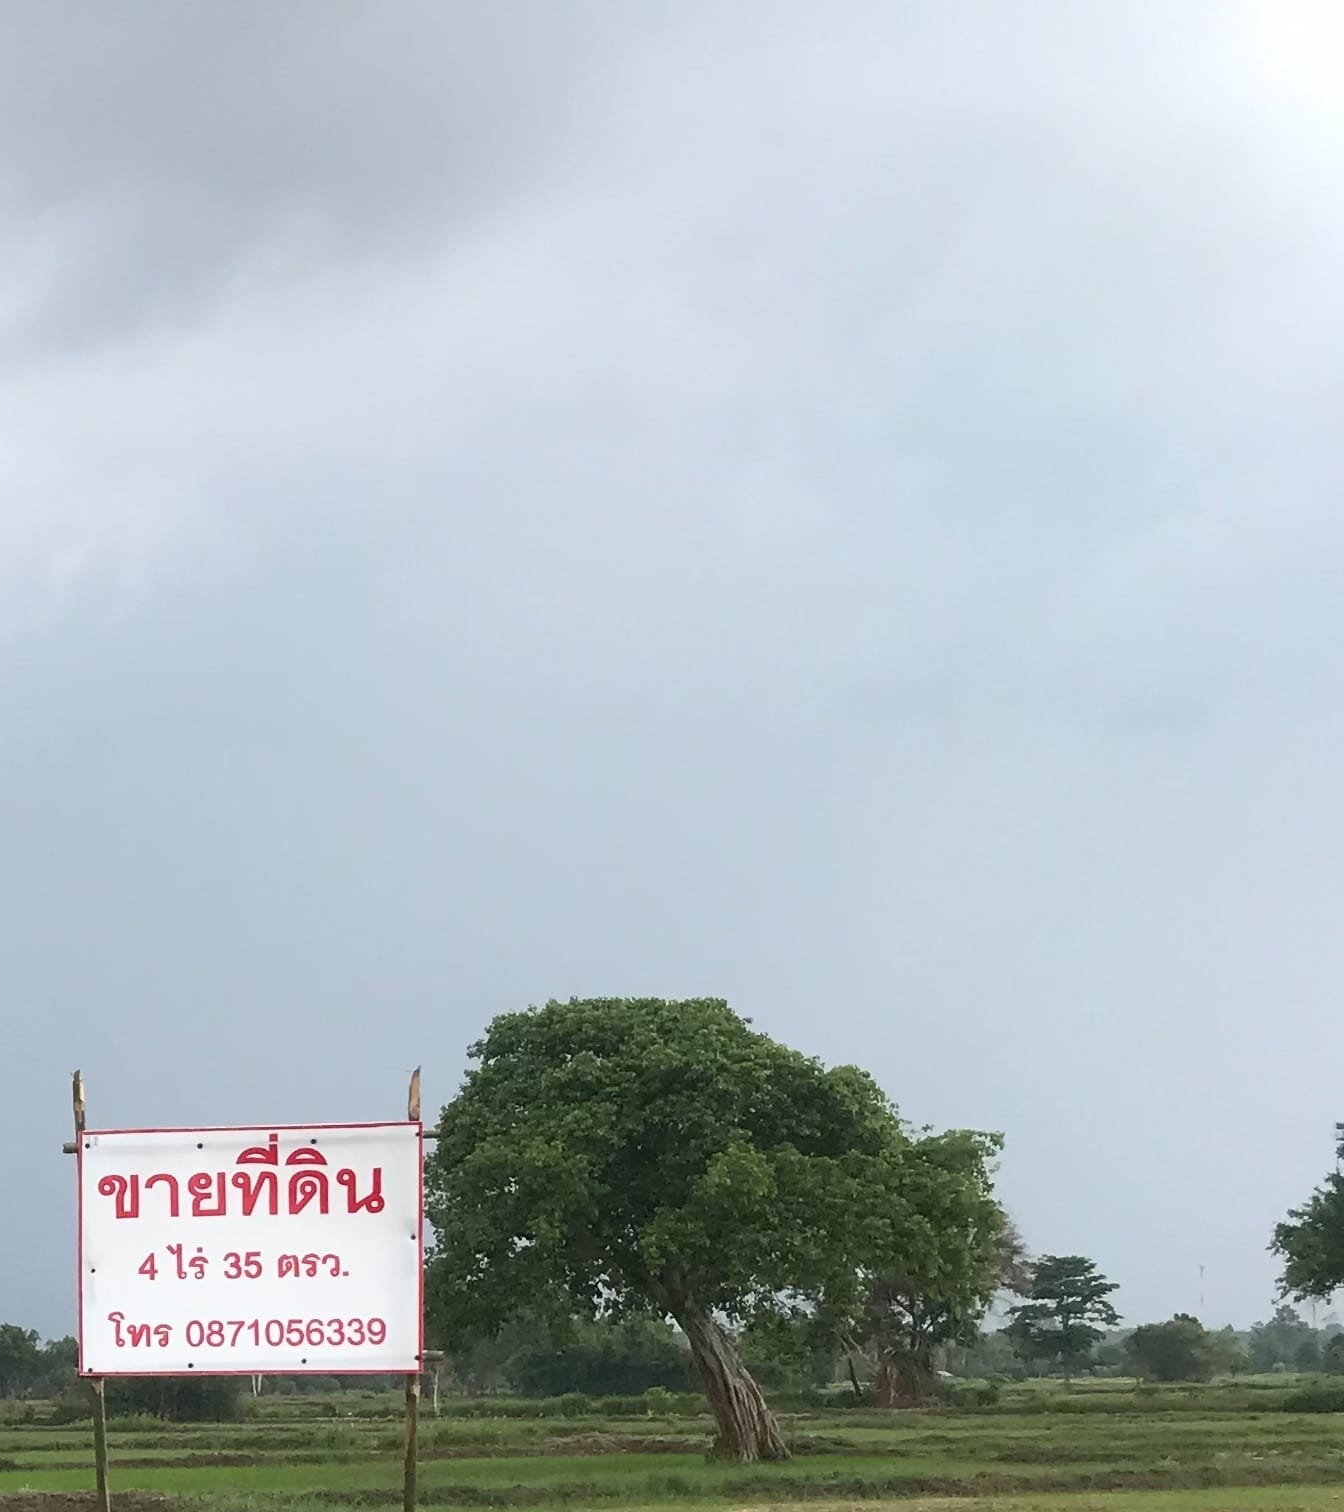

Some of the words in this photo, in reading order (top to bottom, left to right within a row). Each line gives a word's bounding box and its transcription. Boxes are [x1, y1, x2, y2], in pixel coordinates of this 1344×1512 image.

[98, 1133, 385, 1219] ขายที่ดิน
[137, 1253, 158, 1280] 4
[167, 1243, 209, 1280] ไร่
[223, 1251, 263, 1279] 35
[277, 1253, 349, 1278] ตรว.
[108, 1311, 173, 1348] โทร
[185, 1317, 387, 1348] 0871056339
